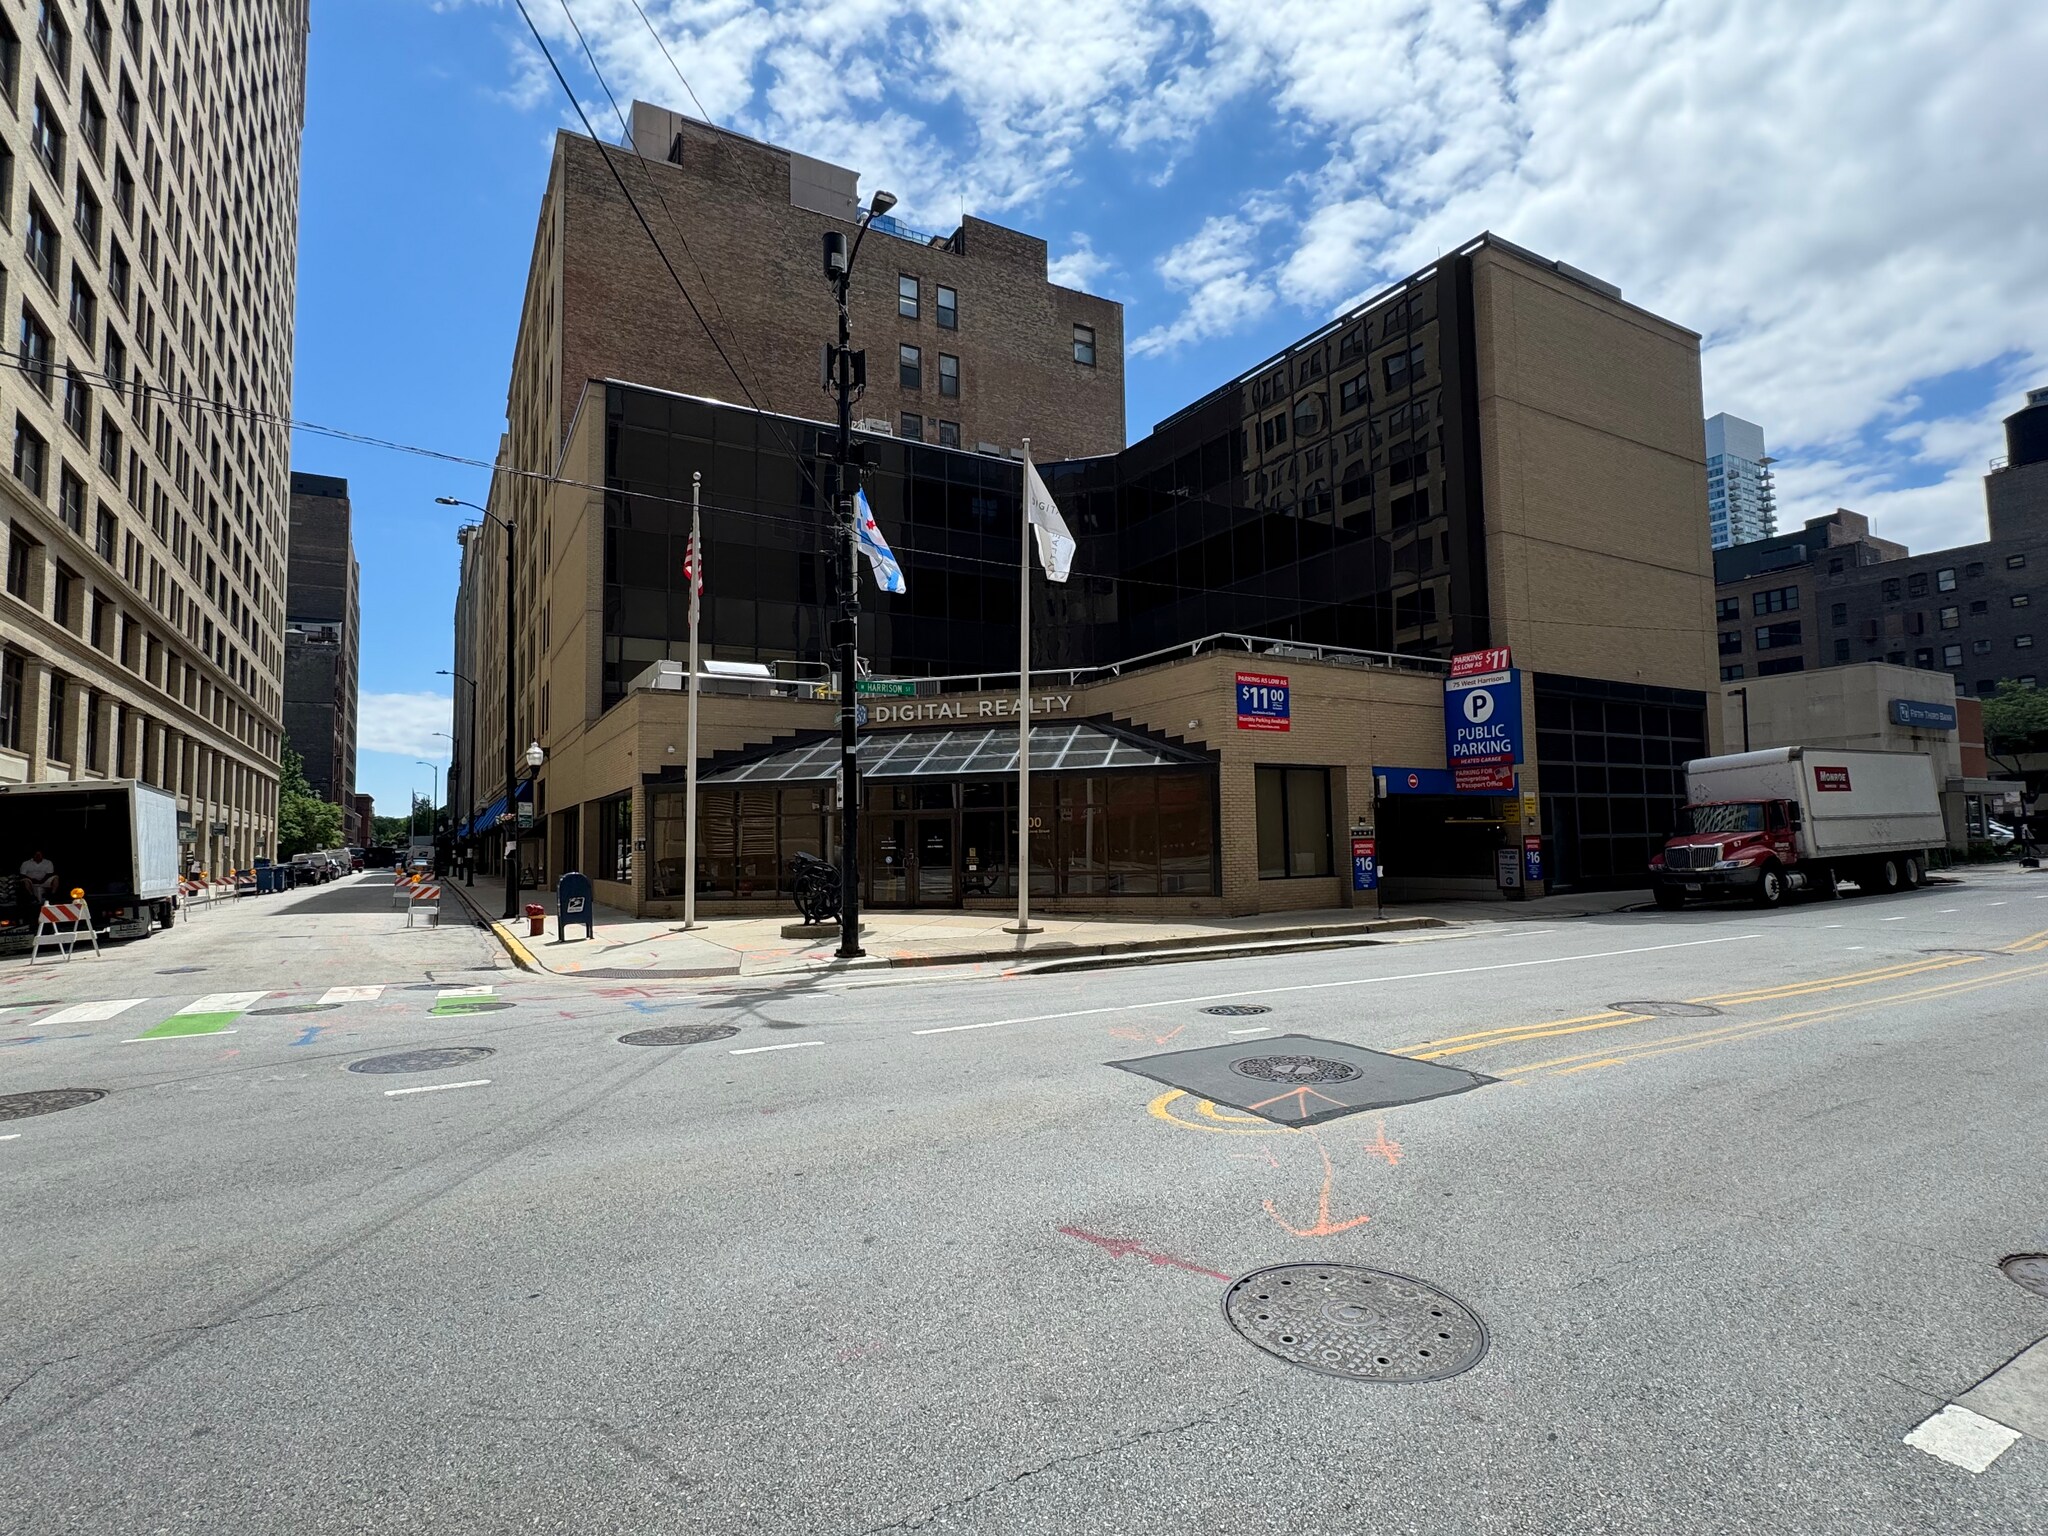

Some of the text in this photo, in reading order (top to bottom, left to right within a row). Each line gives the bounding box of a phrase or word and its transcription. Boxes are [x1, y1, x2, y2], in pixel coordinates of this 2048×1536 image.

[1032, 496, 1059, 515] IGIT
[1453, 649, 1508, 669] PARKING $11
[1461, 662, 1474, 671] LOW
[1237, 675, 1261, 683] PARKING
[1477, 676, 1505, 685] Harrison
[867, 682, 903, 693] HARRISON
[875, 695, 1072, 723] DIGITAL REALTY
[1472, 695, 1487, 718] P
[1457, 723, 1505, 741] PUBLIC
[1453, 739, 1511, 757] PARKING
[1455, 768, 1480, 776] PARKING
[1355, 856, 1373, 871] $16
[1526, 851, 1541, 864] $16
